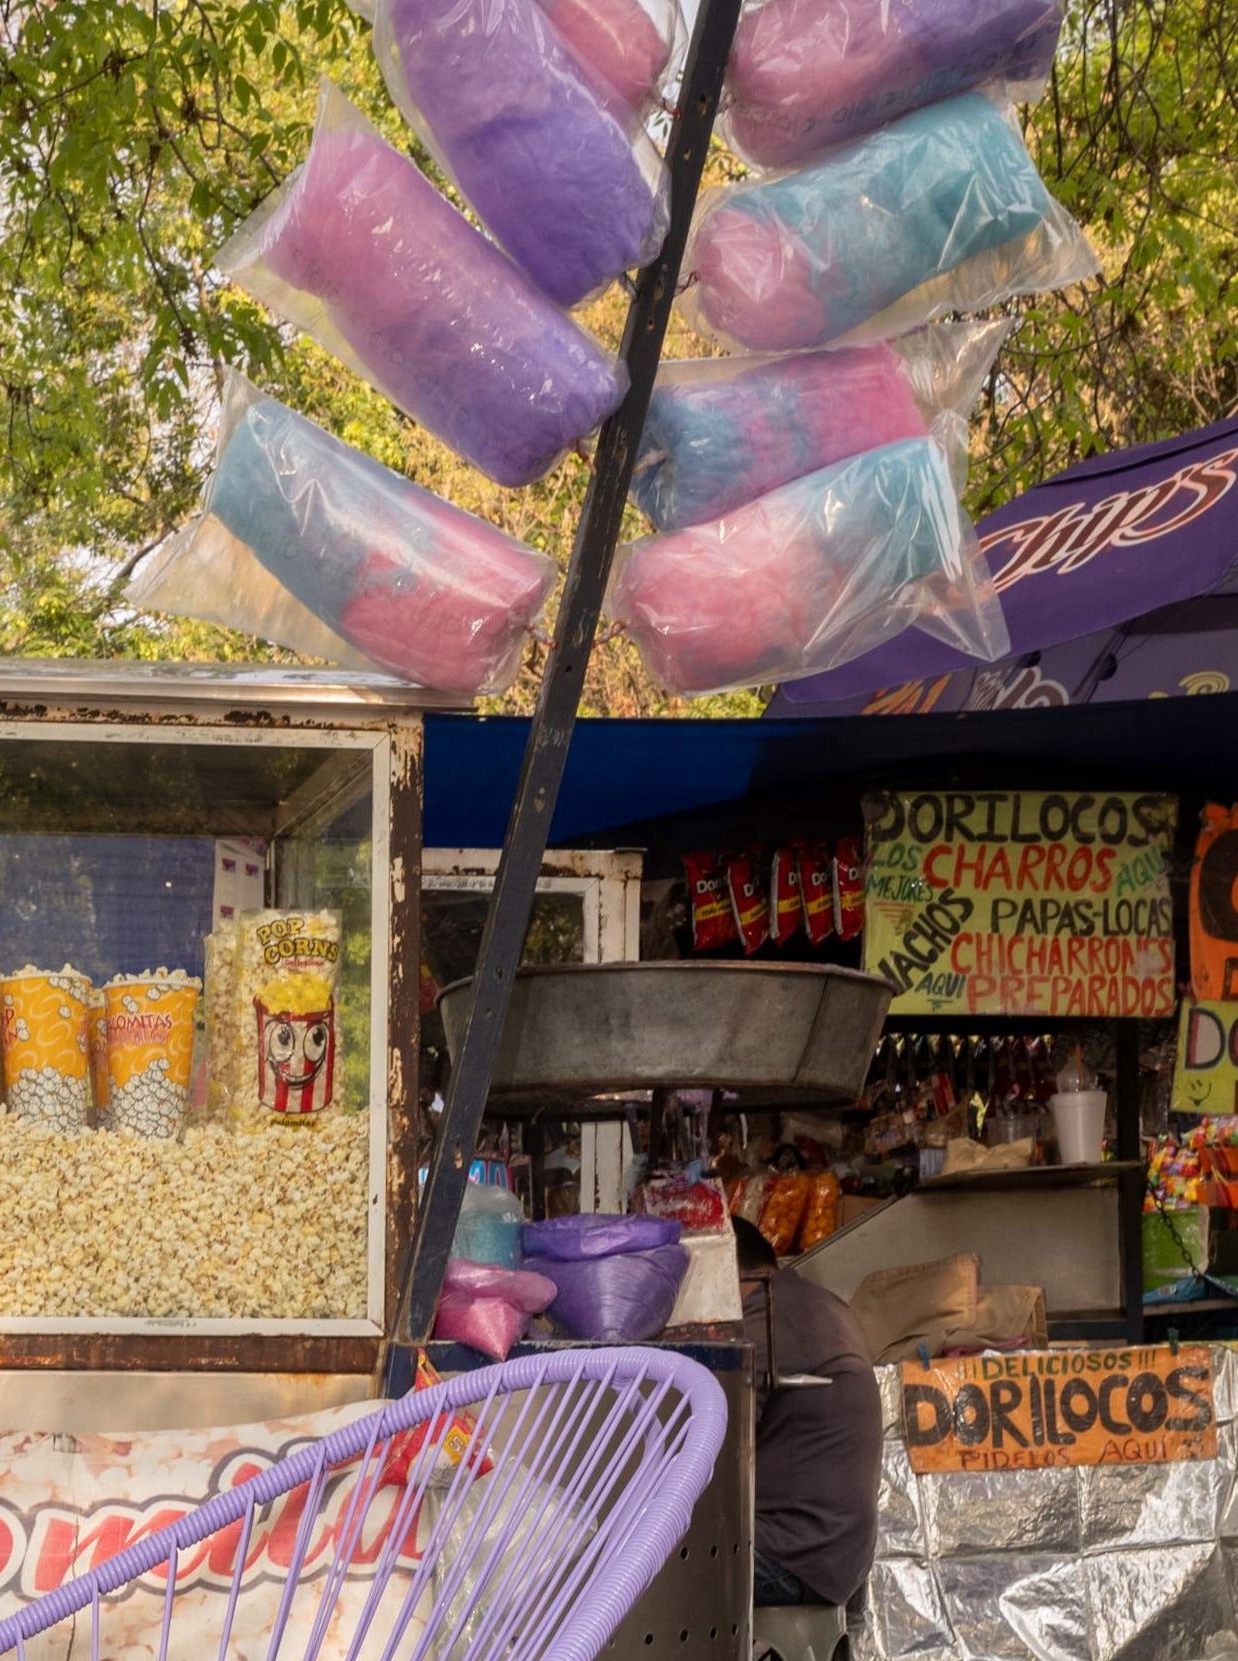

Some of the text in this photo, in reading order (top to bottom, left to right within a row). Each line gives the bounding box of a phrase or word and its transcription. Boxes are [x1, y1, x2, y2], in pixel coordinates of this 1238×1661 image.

[922, 843, 1117, 893] CHARROS
[255, 917, 305, 945] POP
[264, 937, 339, 965] CORNS
[915, 973, 967, 998] AQUI
[966, 973, 1173, 1016] PREPARADOS
[904, 1366, 1213, 1447] DORILOCOS
